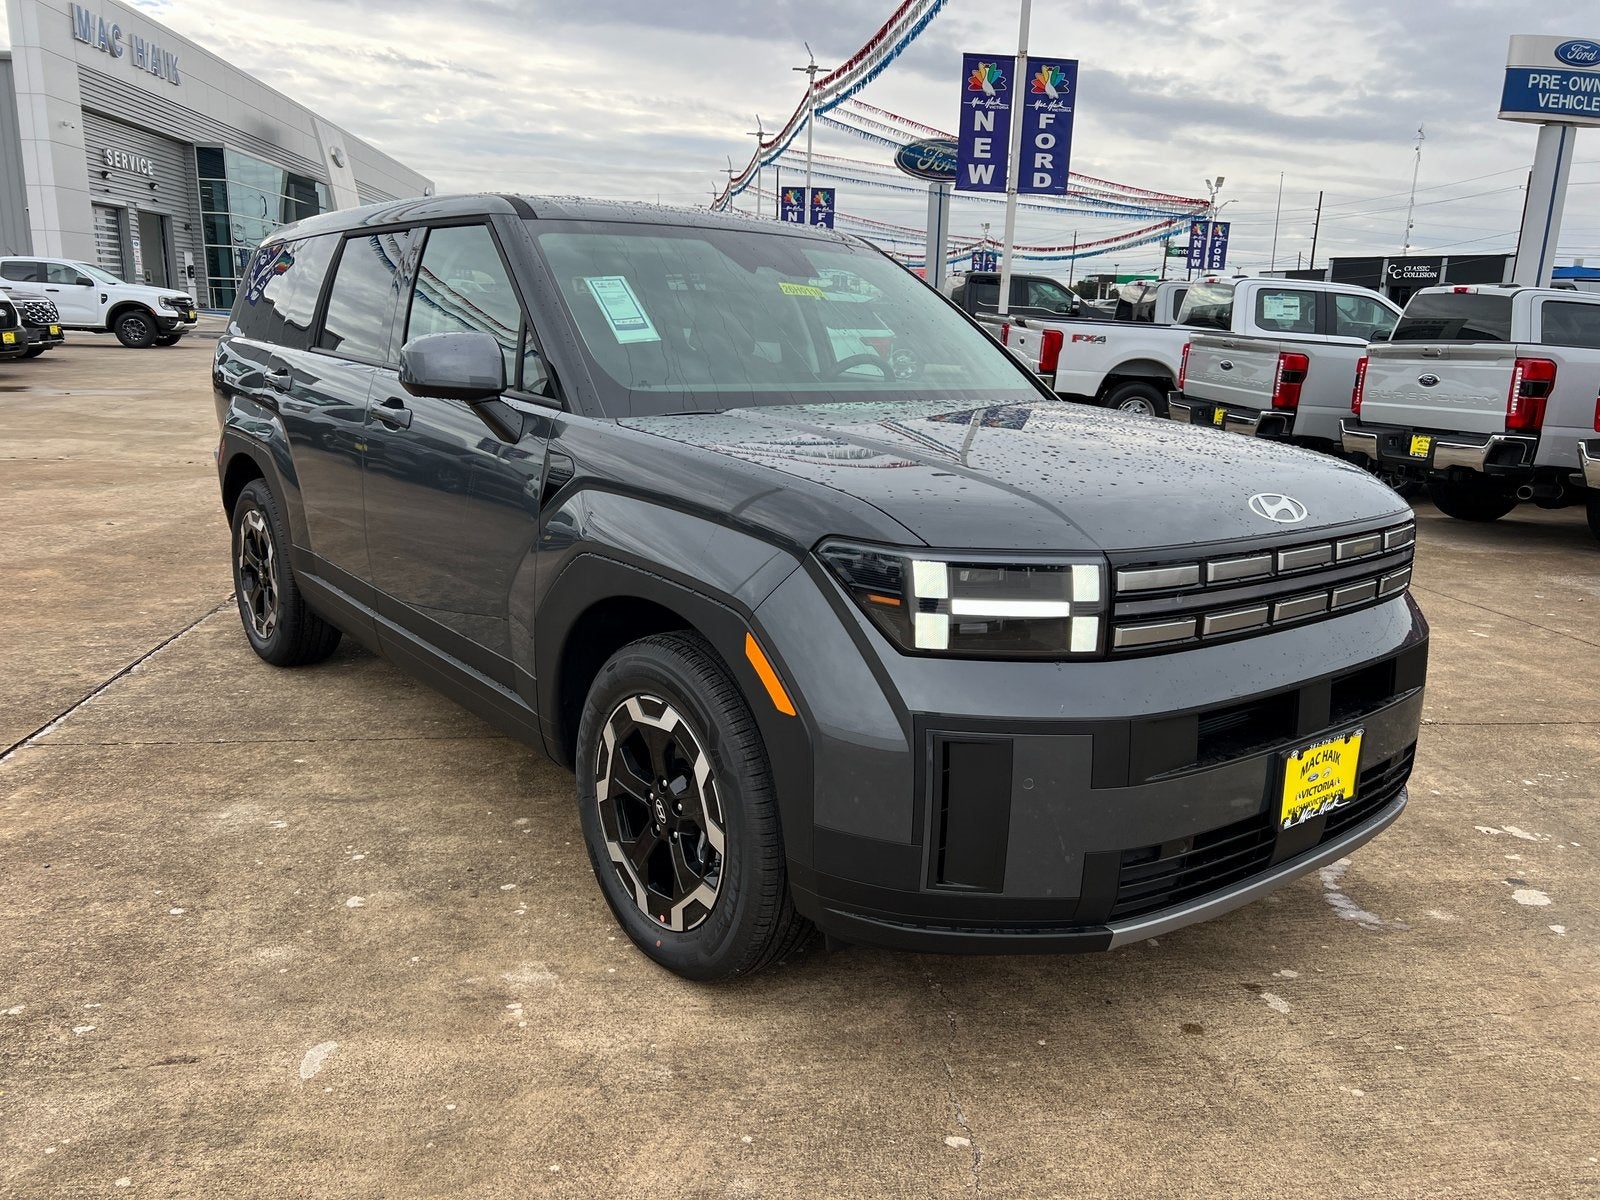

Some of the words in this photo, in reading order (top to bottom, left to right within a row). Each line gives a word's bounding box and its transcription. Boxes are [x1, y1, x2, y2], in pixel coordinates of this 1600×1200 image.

[71, 3, 123, 58] MAC
[130, 34, 181, 86] HAIK
[1567, 43, 1598, 61] Ford
[1538, 92, 1600, 111] VEHICLE
[968, 110, 995, 185] NEW
[1032, 113, 1056, 188] FORD
[106, 148, 154, 176] SERVICE
[1191, 240, 1202, 267] NEW
[1212, 241, 1222, 268] FORD
[1072, 334, 1107, 344] FX4
[1368, 389, 1432, 402] SUPER
[1300, 752, 1321, 779] MAC
[1322, 750, 1341, 766] HAIK
